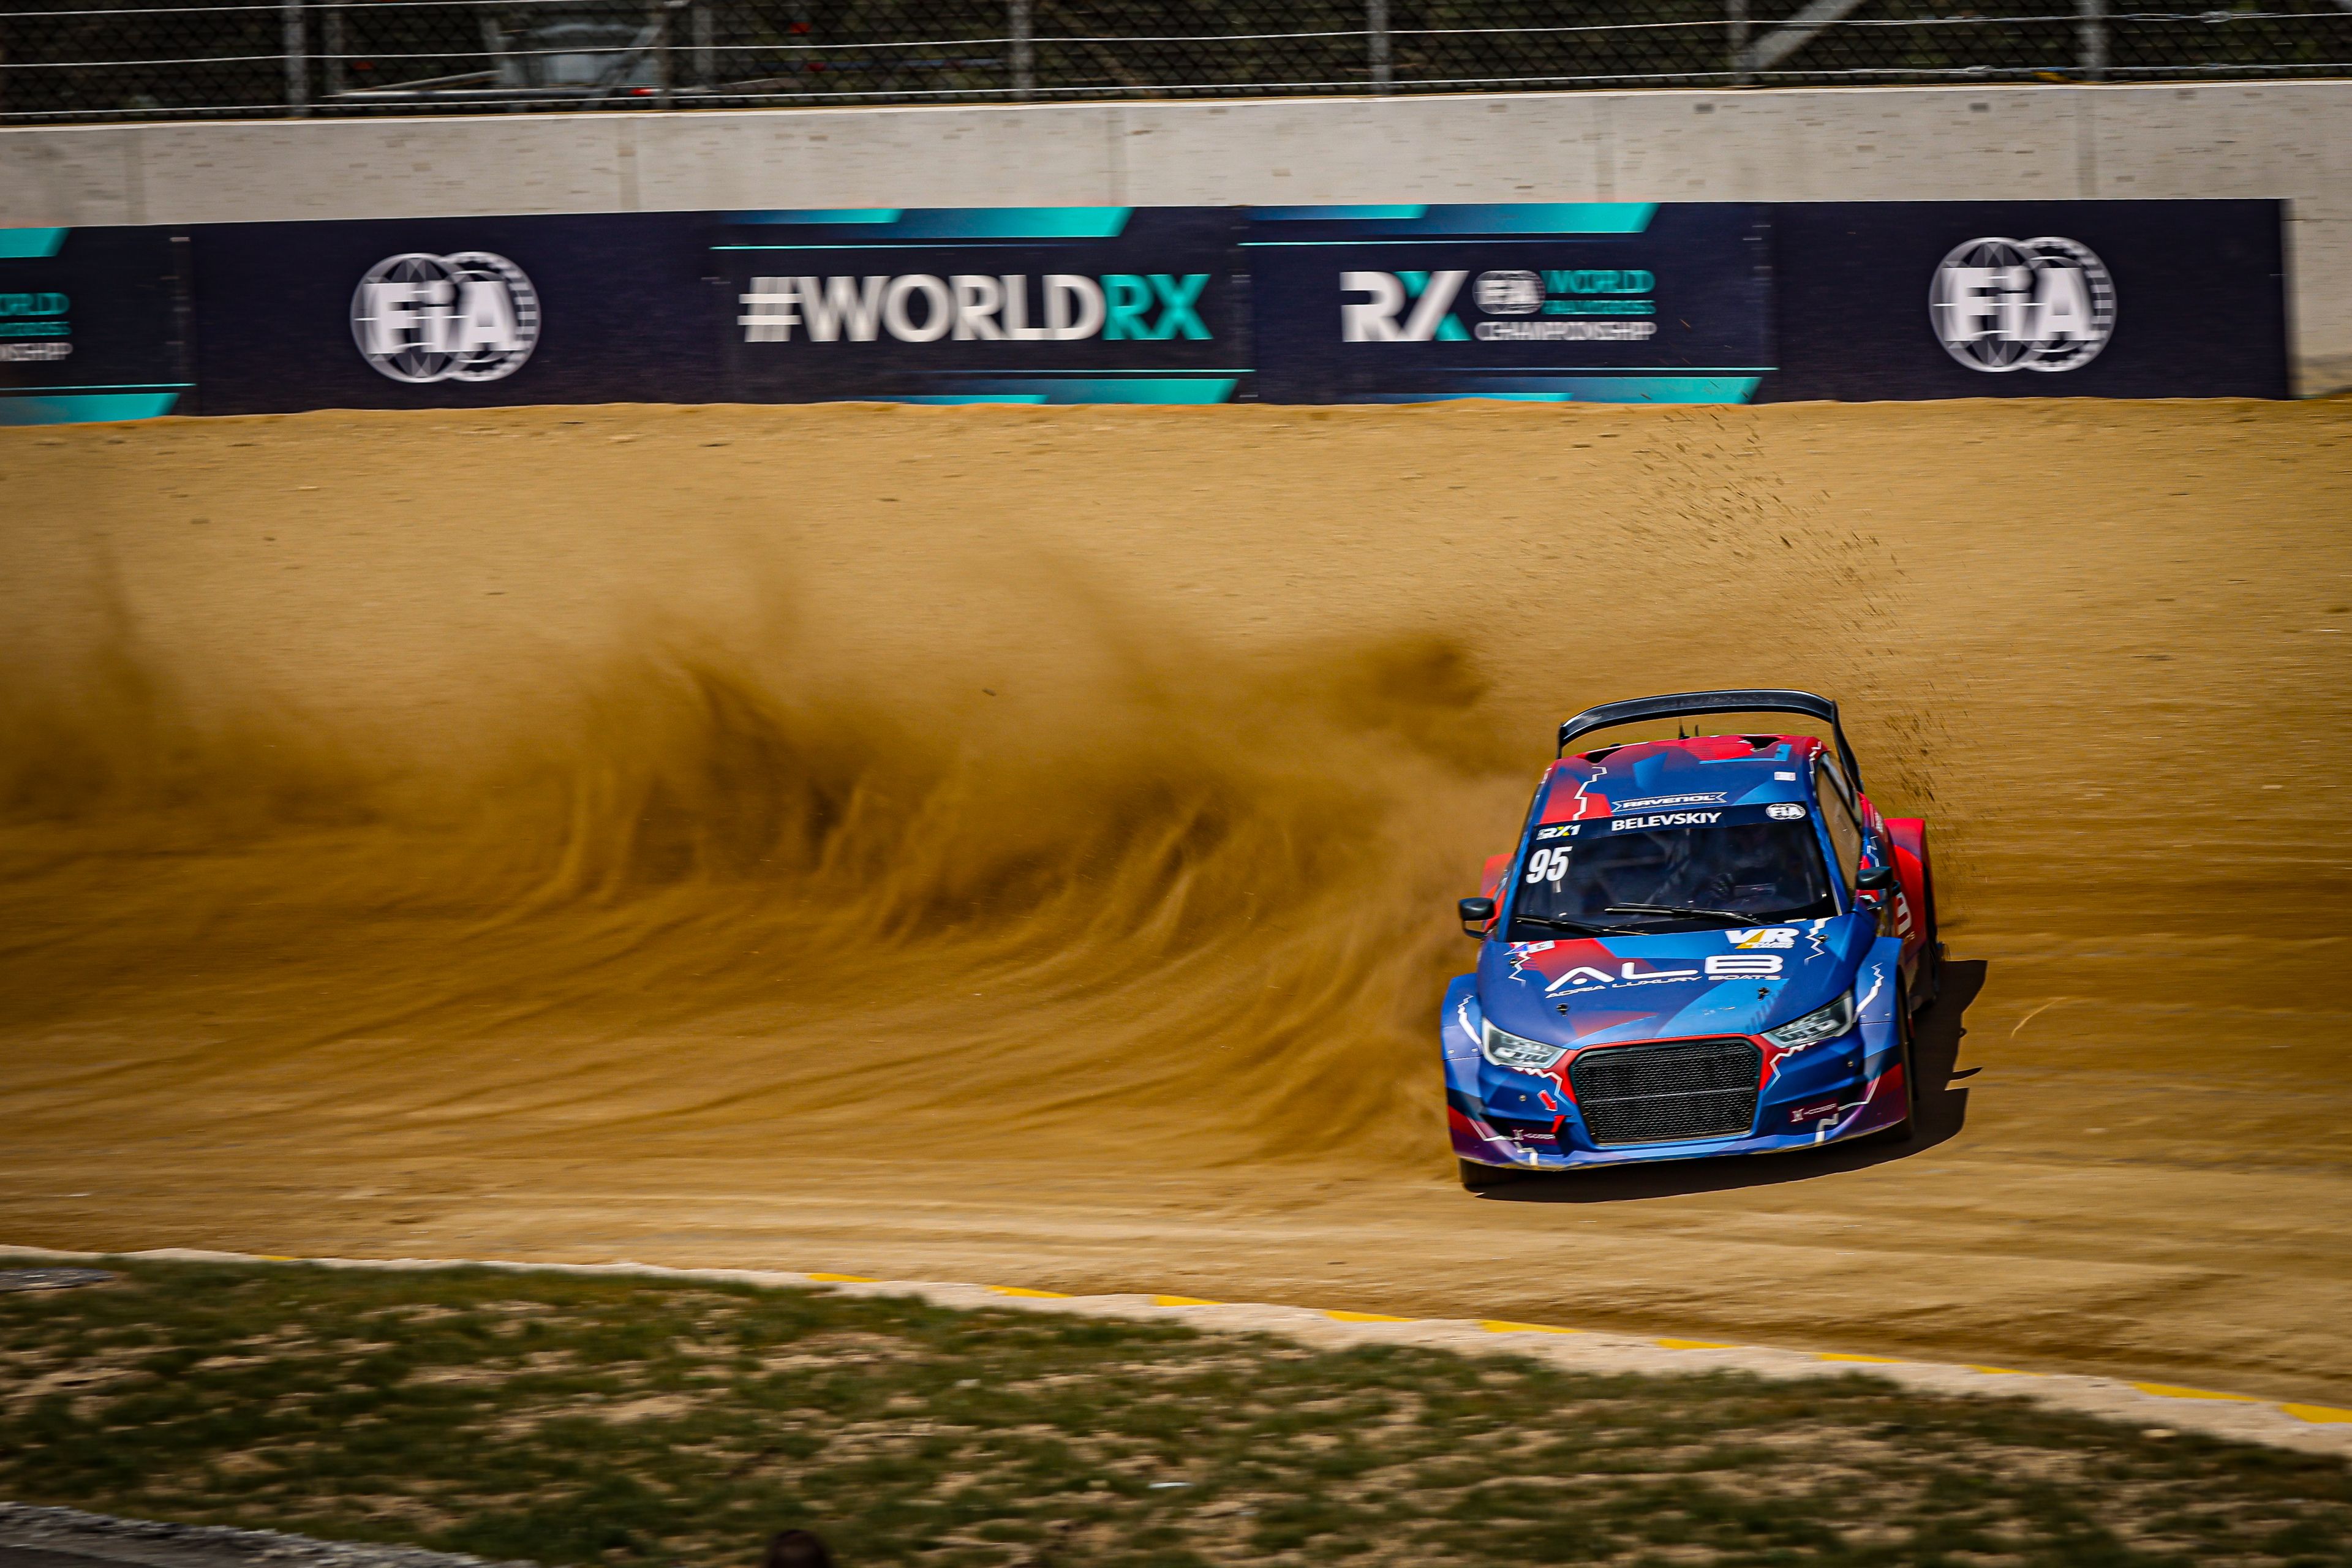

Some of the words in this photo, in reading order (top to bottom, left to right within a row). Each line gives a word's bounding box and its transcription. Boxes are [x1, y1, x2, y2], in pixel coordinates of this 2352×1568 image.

[1541, 270, 1656, 293] WORLD
[737, 273, 1214, 342] #WORLDRX
[1340, 270, 1471, 342] RX
[1623, 795, 1716, 808] RAVENOL
[1611, 812, 1722, 831] BELEVSKIY
[1526, 846, 1573, 884] 95
[1725, 928, 1800, 944] VR
[1544, 954, 1783, 992] ALB
[1545, 985, 1606, 998] ADRIA
[1612, 976, 1702, 988] LUXURY
